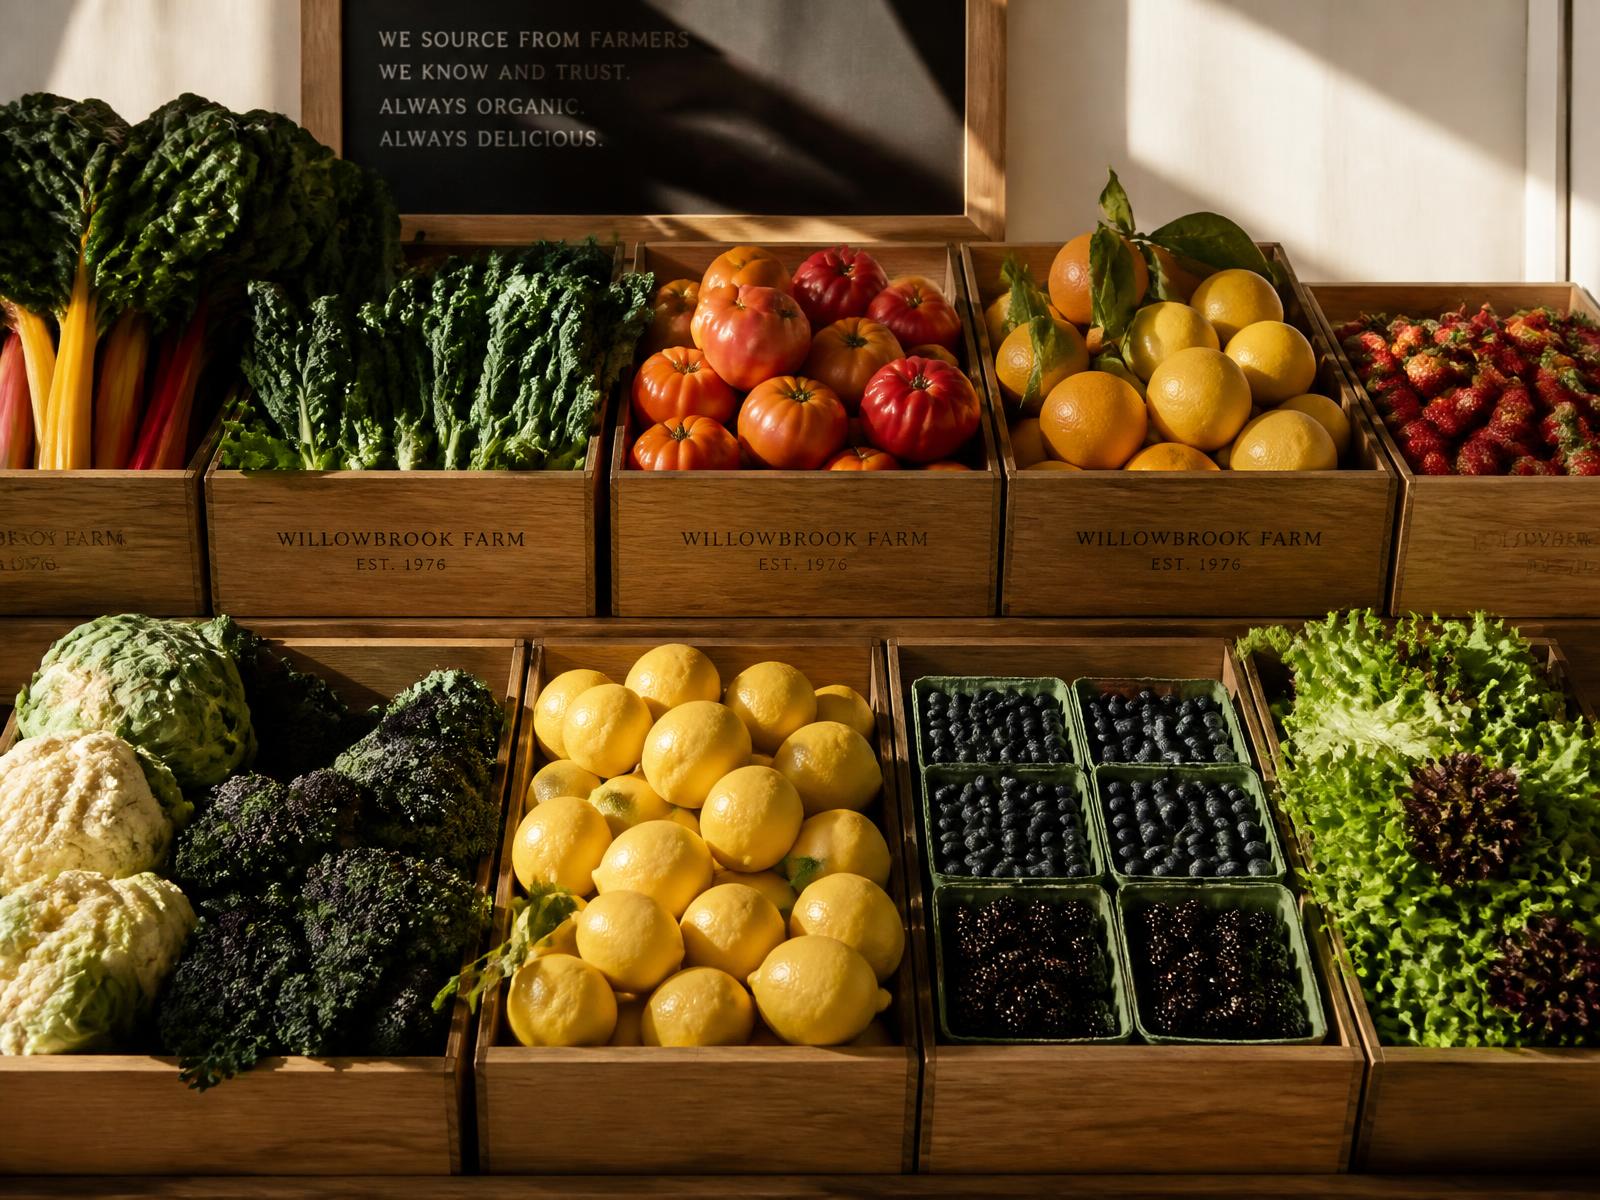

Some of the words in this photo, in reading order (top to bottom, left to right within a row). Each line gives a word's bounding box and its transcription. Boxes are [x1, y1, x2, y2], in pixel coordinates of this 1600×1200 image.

[379, 31, 411, 48] WE
[421, 31, 509, 48] SOURCE
[519, 31, 580, 48] FROM
[590, 31, 690, 48] FARMERS
[379, 64, 412, 80] WE
[421, 64, 489, 80] KNOW
[499, 64, 546, 80] AND
[556, 64, 631, 80] TRUST.
[379, 98, 467, 115] ALWAYS
[477, 98, 585, 115] ORGANIC.
[379, 130, 468, 147] ALWAYS
[478, 130, 603, 147] DELICIOUS.
[277, 531, 454, 547] WILLOWBROOK
[463, 531, 526, 547] FARM
[681, 531, 858, 547] WILLOWBROOK
[868, 531, 928, 547] FARM
[1076, 531, 1251, 547] WILLOWBROOK
[1260, 531, 1323, 547] FARM
[356, 558, 395, 571] EST.
[405, 558, 447, 571] 1976
[759, 558, 798, 571] EST.
[807, 558, 848, 571] 1976
[1151, 558, 1190, 571] EST.
[1200, 558, 1241, 571] 1976
